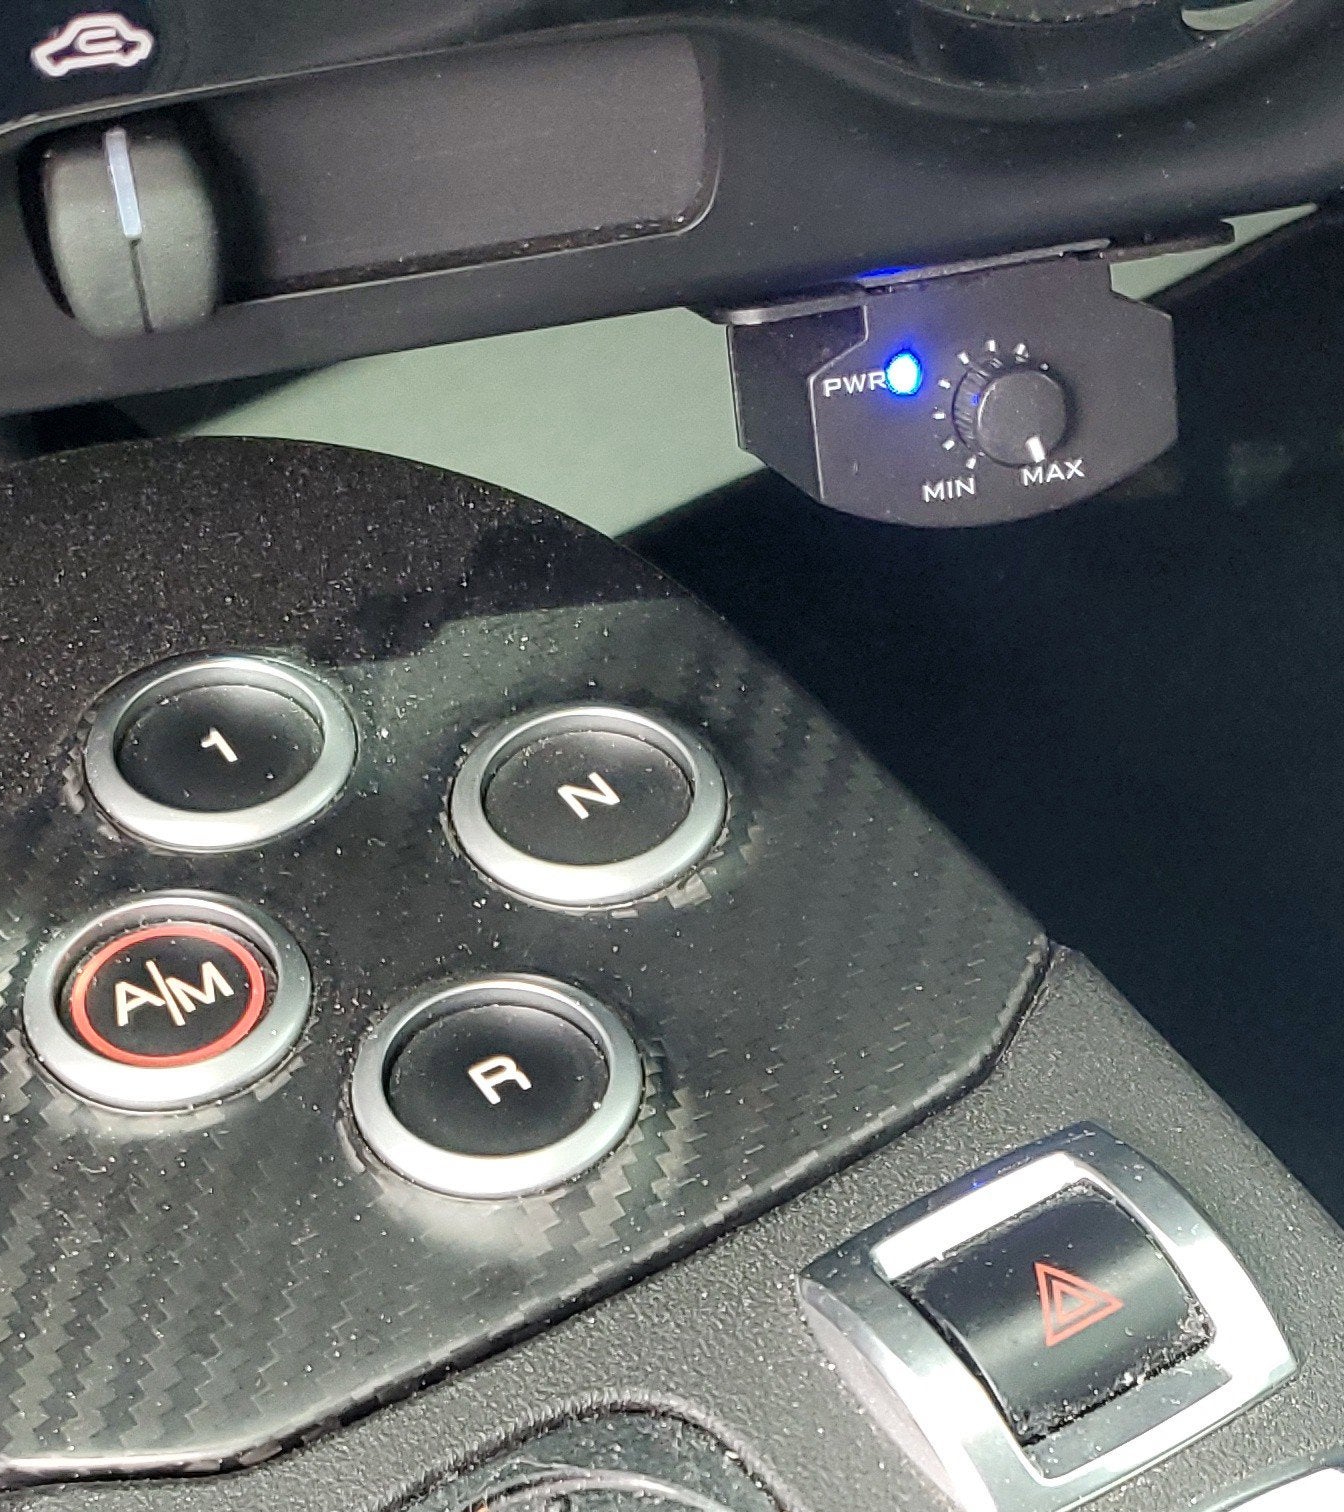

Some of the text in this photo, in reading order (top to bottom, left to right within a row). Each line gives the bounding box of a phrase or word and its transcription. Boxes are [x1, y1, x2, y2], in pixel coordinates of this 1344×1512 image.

[822, 371, 887, 398] PWR
[1022, 458, 1084, 487] MAX
[923, 477, 976, 503] MIN
[199, 726, 238, 763] 1
[557, 771, 621, 819] N
[467, 1053, 532, 1106] R
